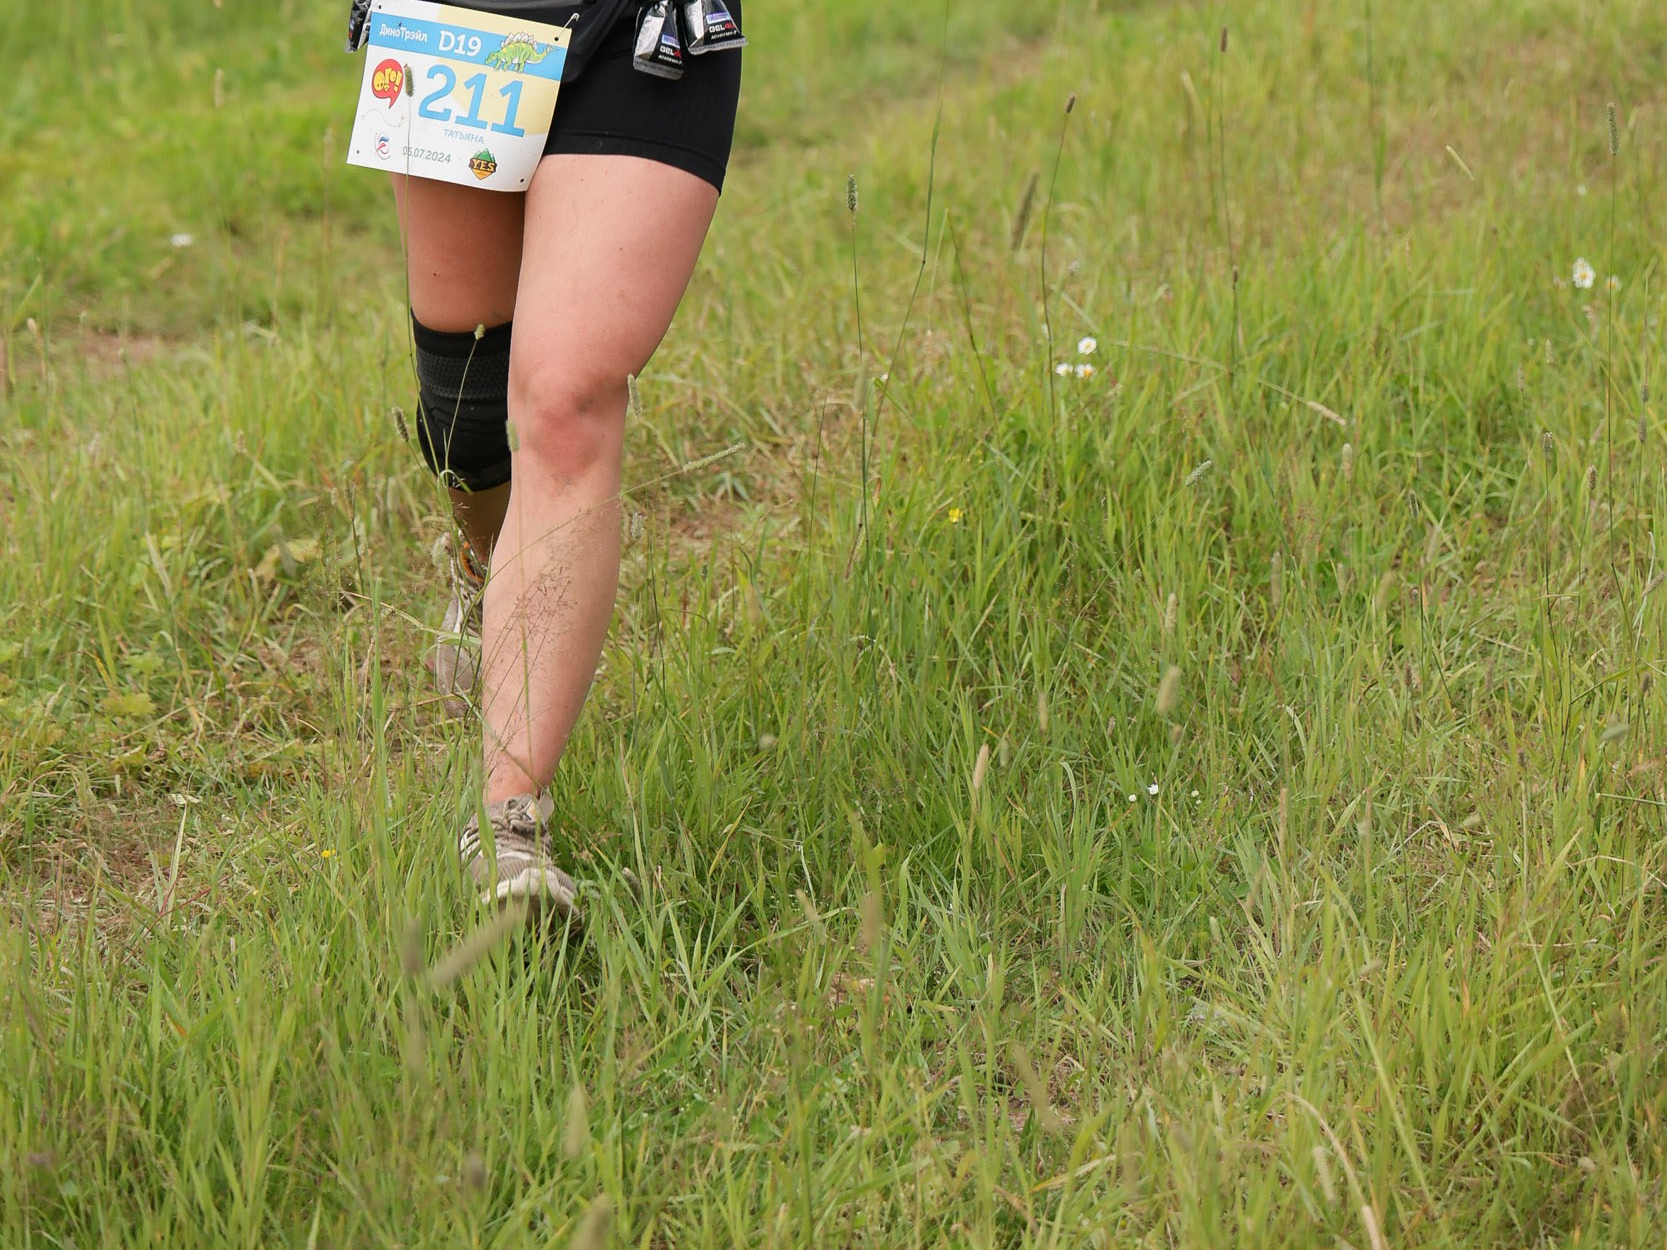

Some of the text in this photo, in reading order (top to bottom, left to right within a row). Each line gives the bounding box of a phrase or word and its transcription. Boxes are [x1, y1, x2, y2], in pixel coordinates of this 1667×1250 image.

[379, 23, 428, 42] ДиноТрэйл
[438, 30, 481, 57] D19
[418, 64, 525, 138] 211
[443, 128, 484, 144] ТАТЬЯНА
[472, 158, 495, 172] YES
